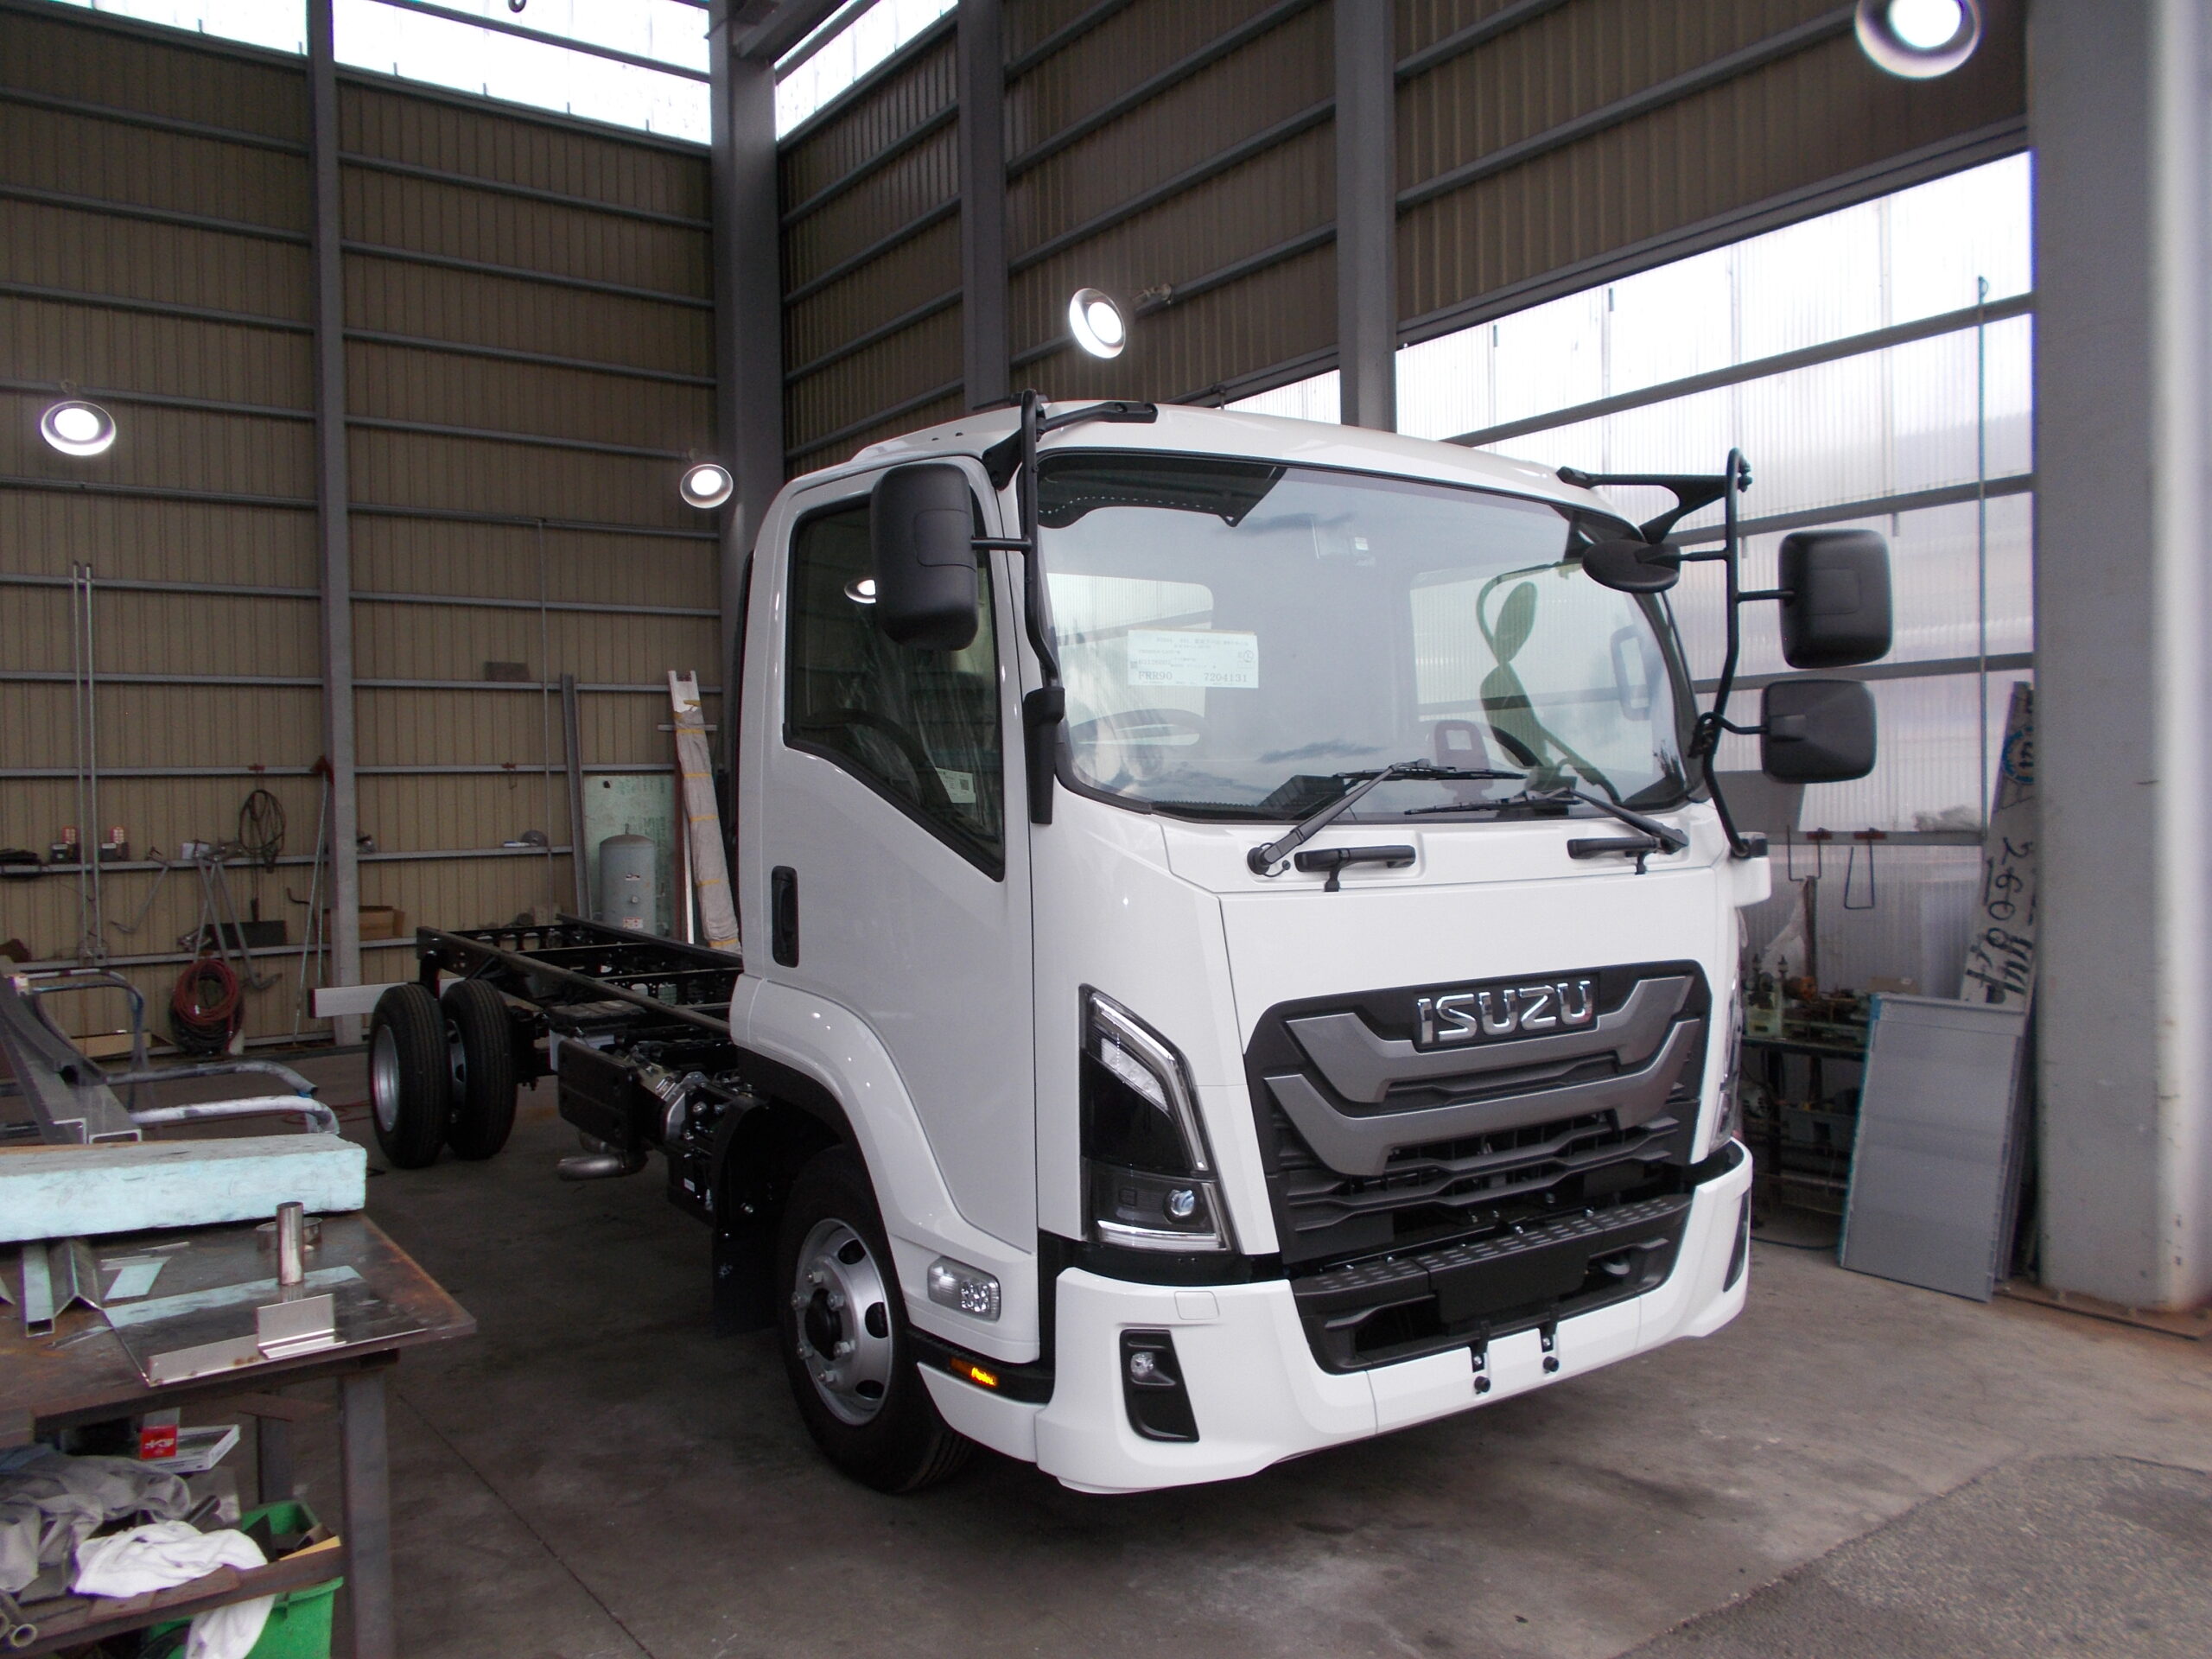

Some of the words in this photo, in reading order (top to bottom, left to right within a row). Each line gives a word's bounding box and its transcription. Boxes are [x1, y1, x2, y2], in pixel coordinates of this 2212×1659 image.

[1138, 671, 1173, 681] FRR90
[1203, 672, 1247, 683] 7204131
[1418, 980, 1592, 1044] ISUZU
